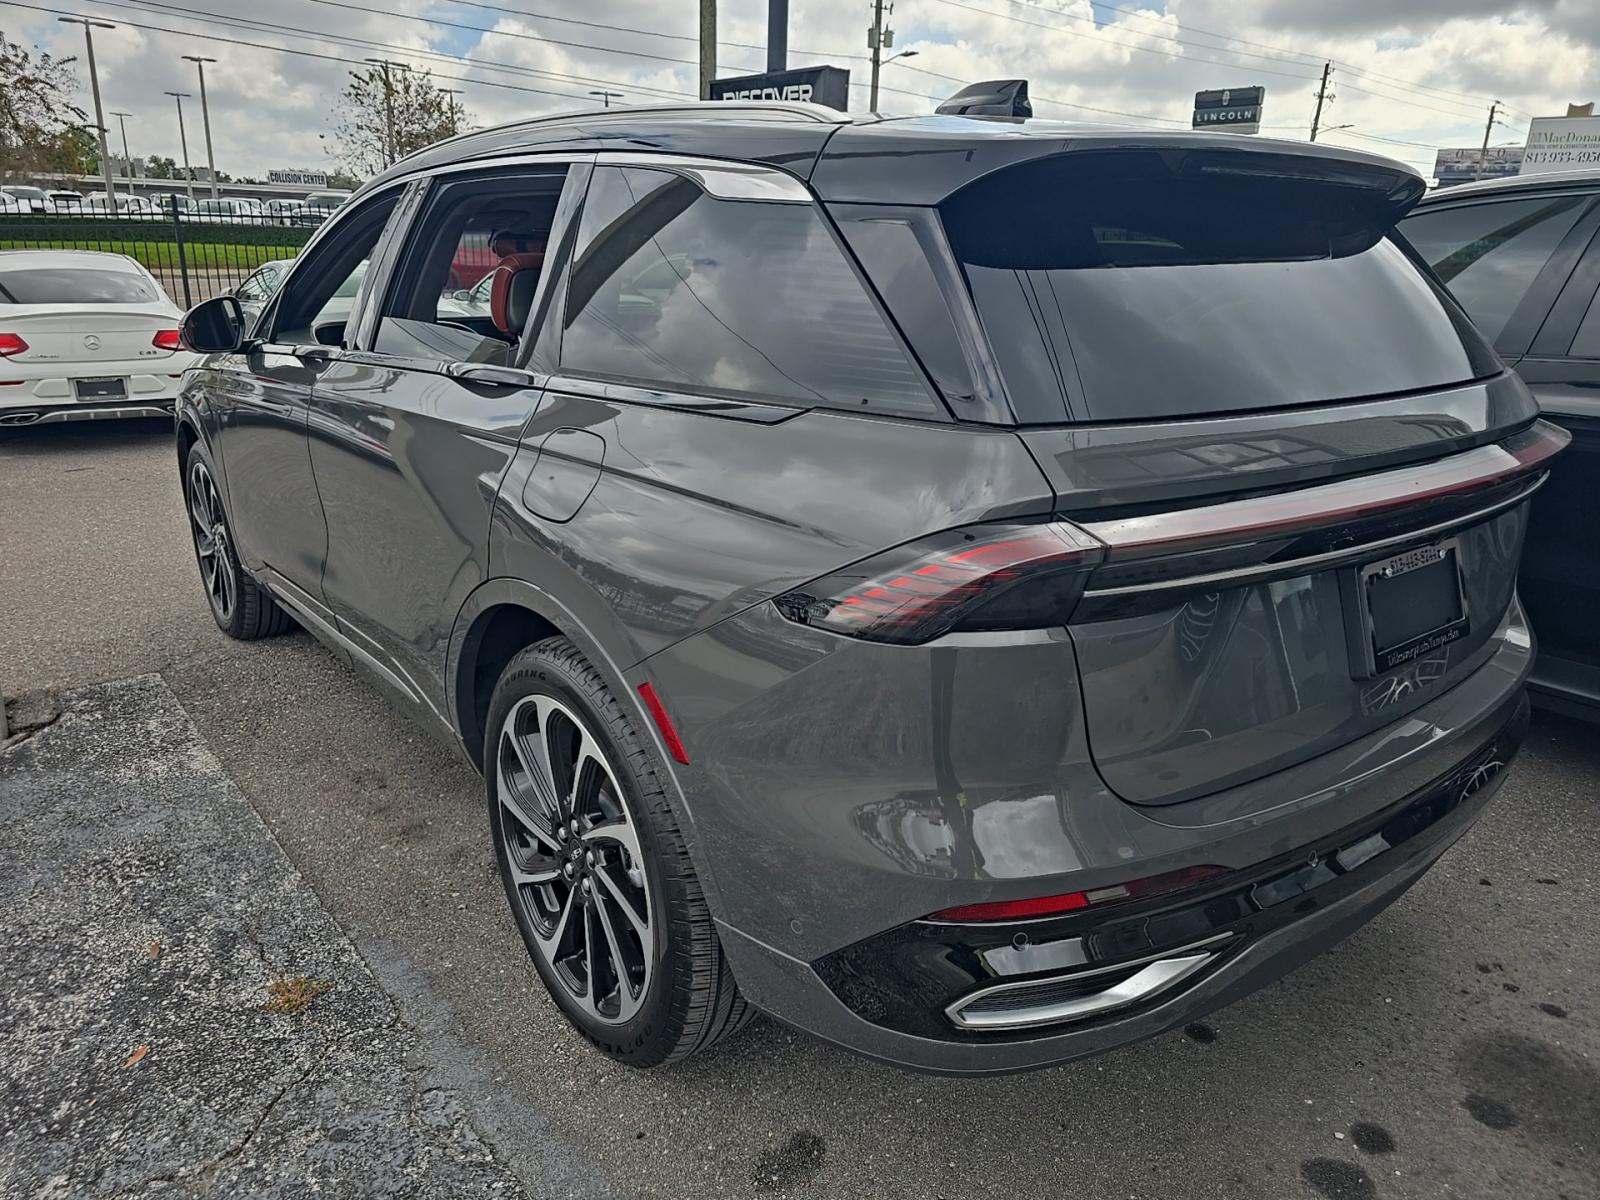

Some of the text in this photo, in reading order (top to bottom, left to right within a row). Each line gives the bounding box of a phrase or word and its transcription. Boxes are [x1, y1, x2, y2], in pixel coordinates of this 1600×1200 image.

[722, 84, 813, 103] DISCOVER
[1197, 110, 1252, 121] LINCOLN
[270, 172, 325, 185] COLLISION CENTER
[502, 669, 547, 690] OURING
